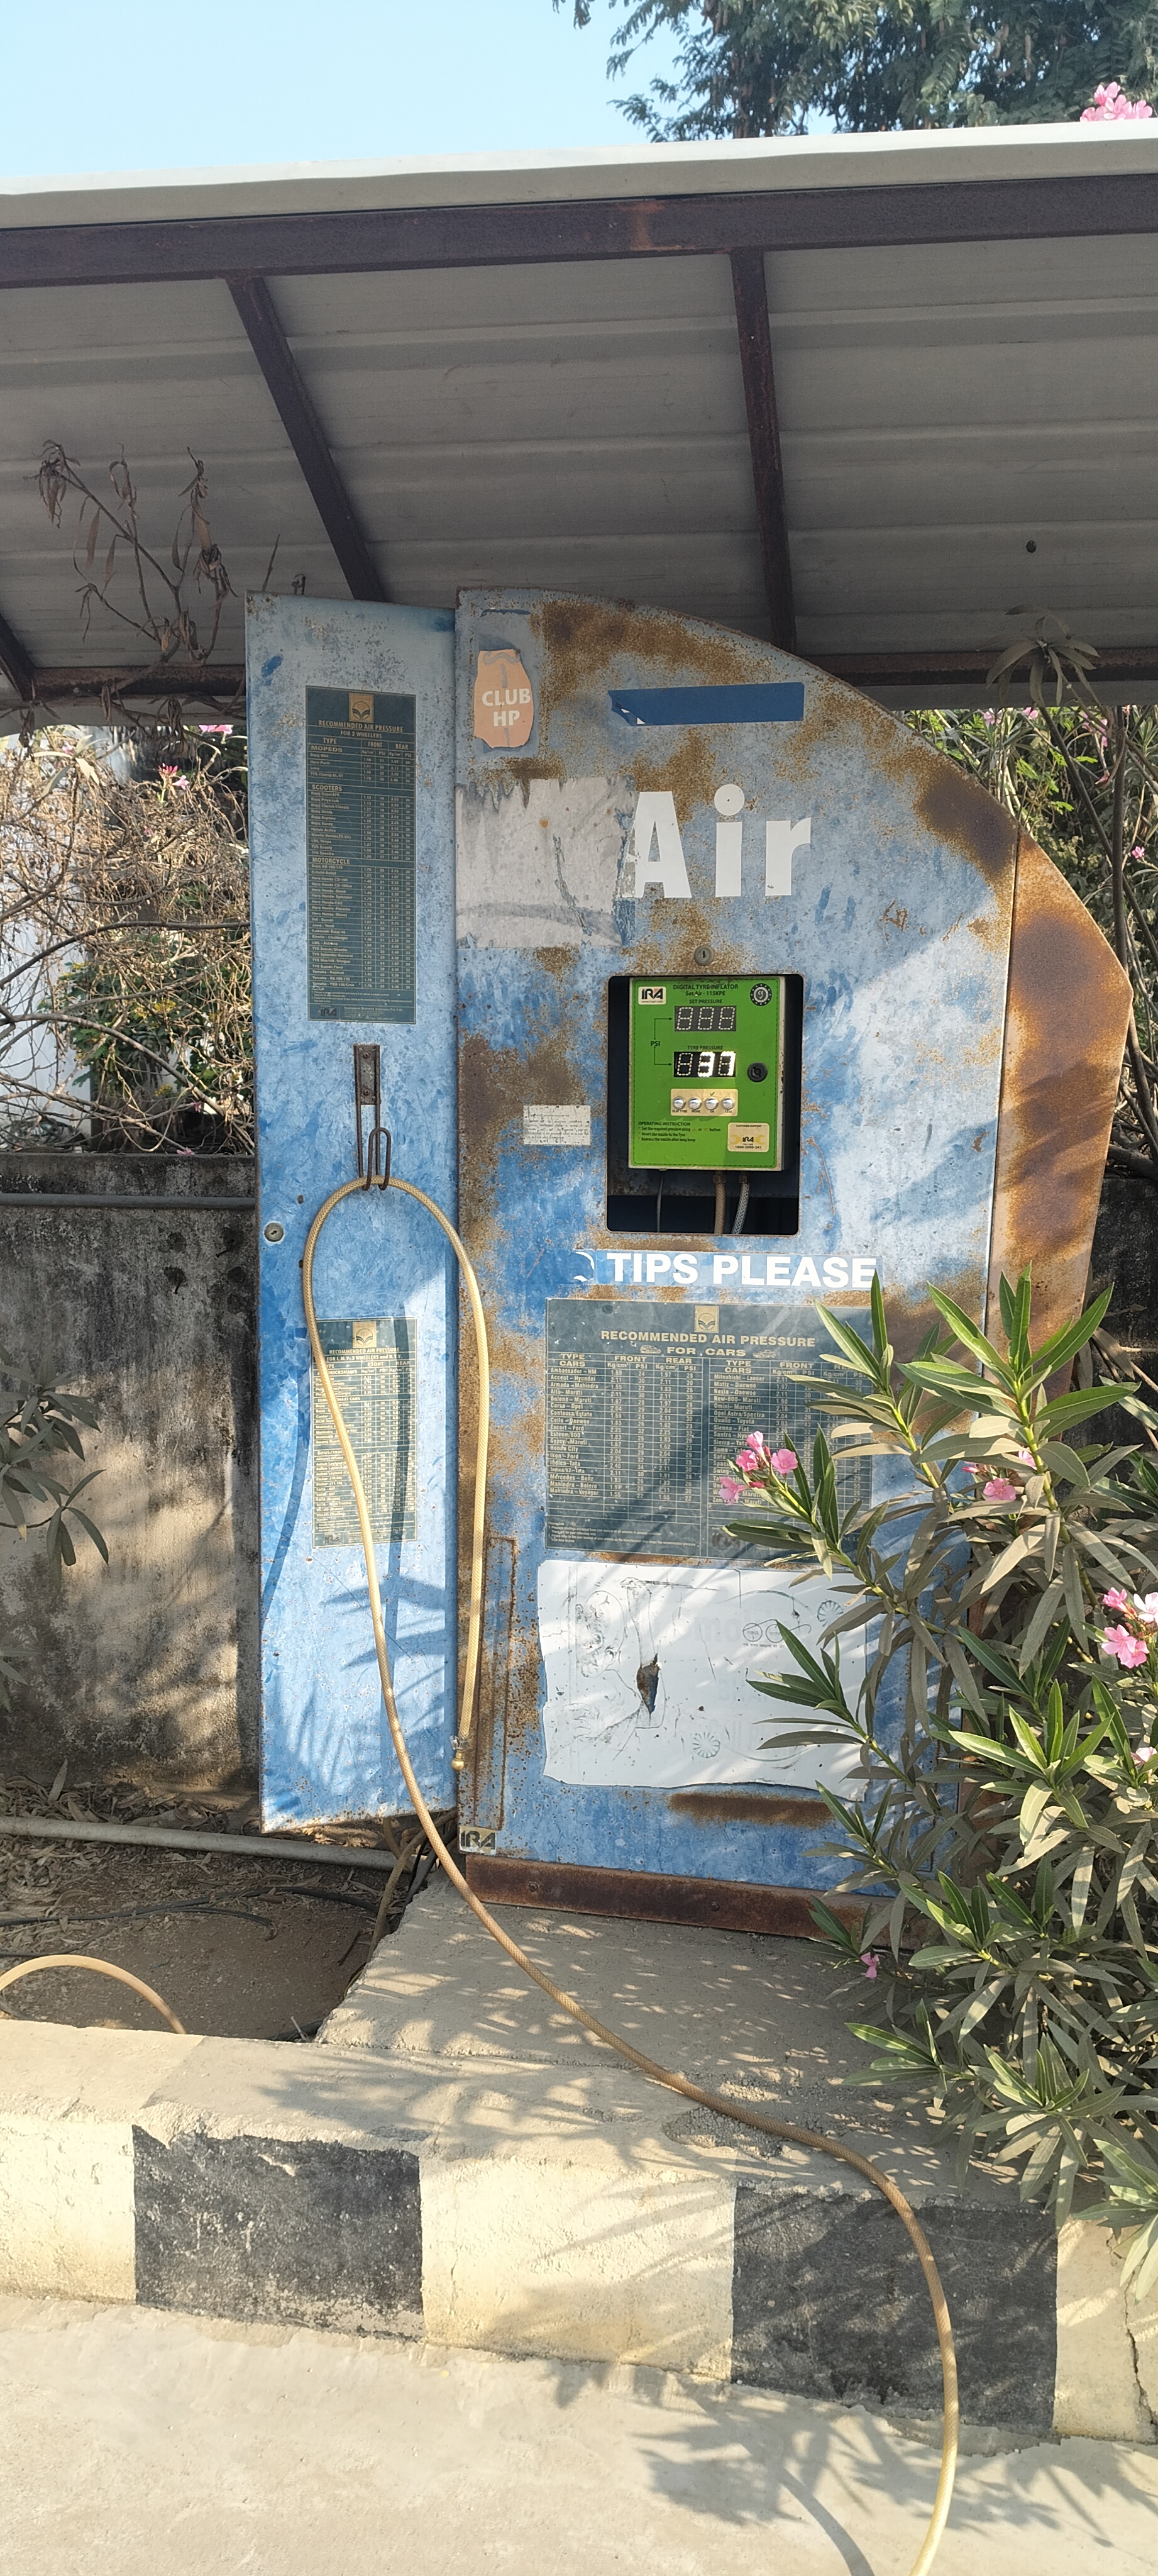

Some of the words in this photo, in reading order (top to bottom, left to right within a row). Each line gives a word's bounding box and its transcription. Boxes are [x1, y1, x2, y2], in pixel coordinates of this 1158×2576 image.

[482, 689, 531, 707] CLUB
[319, 719, 363, 729] RECOMMENDED
[493, 711, 520, 726] HP
[622, 784, 811, 898] Air
[642, 988, 663, 999] IRA
[607, 1252, 698, 1284] TIPS
[713, 1255, 876, 1291] PLEASE
[601, 1331, 707, 1343] RECOMMENDED
[712, 1334, 735, 1345] AIR
[741, 1335, 815, 1347] PRESSURE
[667, 1346, 696, 1356] FOR
[705, 1348, 746, 1357] CARS
[461, 1830, 495, 1850] IRA
